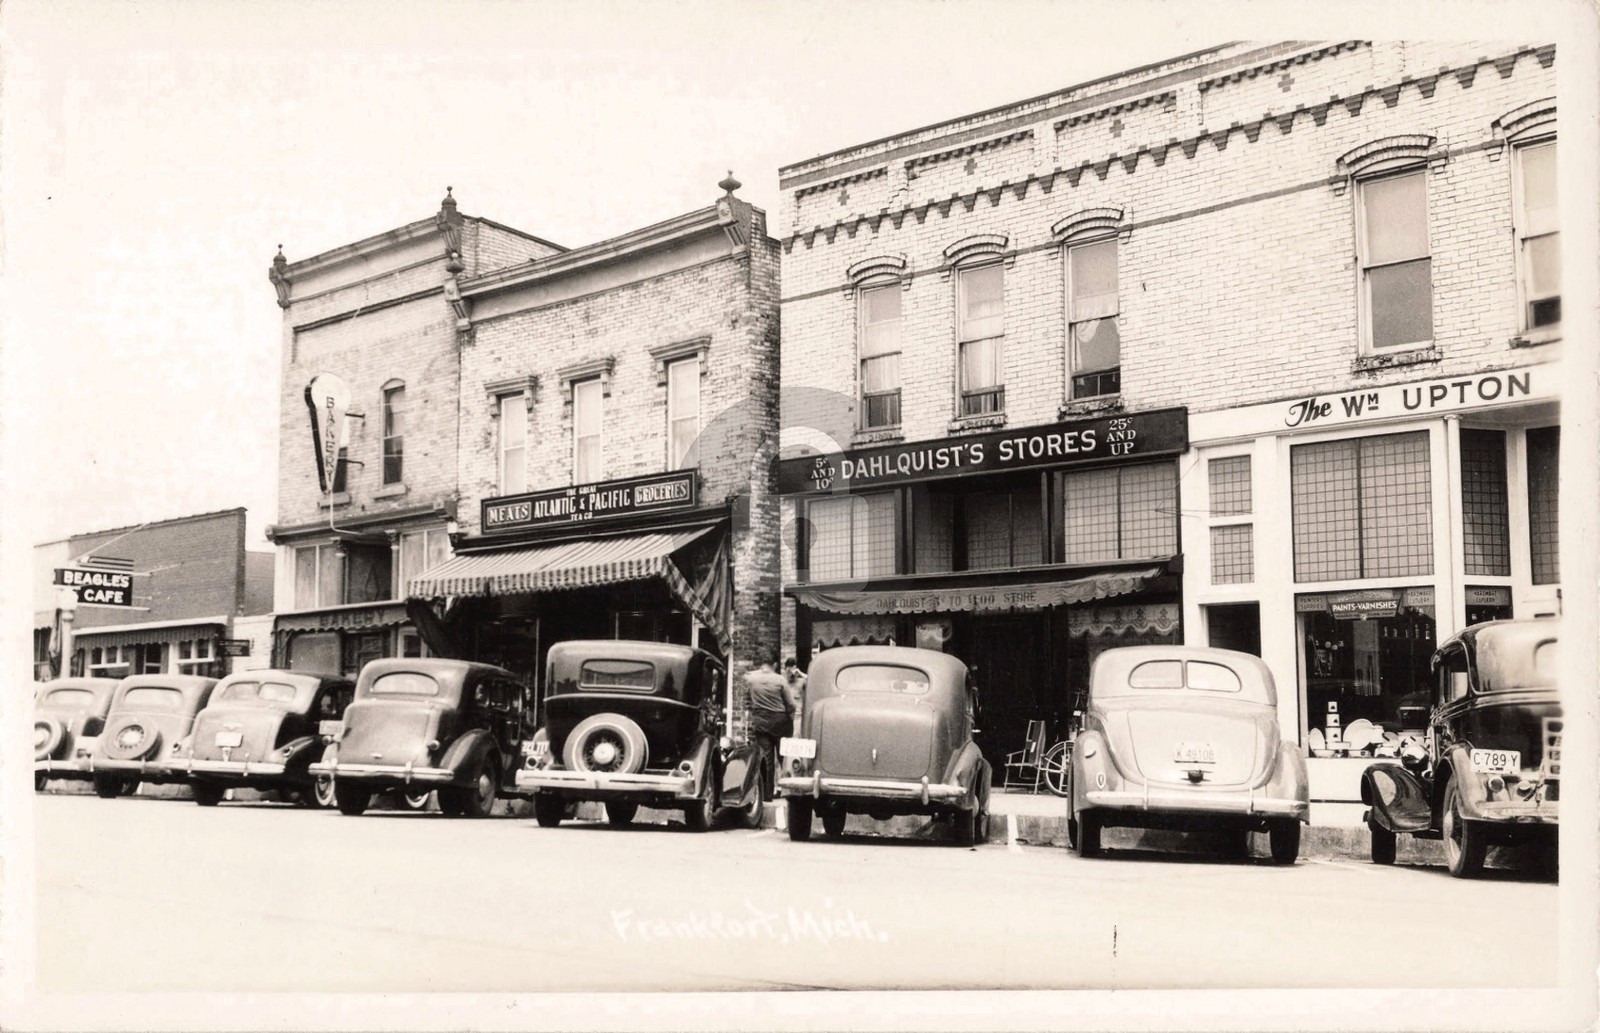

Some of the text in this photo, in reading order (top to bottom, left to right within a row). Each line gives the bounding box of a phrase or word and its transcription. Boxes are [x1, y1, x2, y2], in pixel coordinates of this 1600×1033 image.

[1285, 397, 1333, 427] The
[1403, 373, 1531, 410] UPTON
[325, 396, 336, 482] BAKERY
[1106, 429, 1137, 443] AND
[841, 429, 1096, 480] DAHLQUIST'S STORES
[1110, 441, 1135, 456] UP
[811, 467, 836, 479] AND
[635, 482, 688, 504] GROCERIES
[534, 488, 631, 519] ATLANTIC & PACIFIC
[488, 504, 529, 524] MEATS
[571, 513, 582, 521] TEA
[83, 588, 124, 604] CAFE
[1003, 591, 1038, 603] STORE
[1332, 600, 1397, 612] PAINTS-VARNISHES
[1473, 752, 1518, 767] C 789 Y
